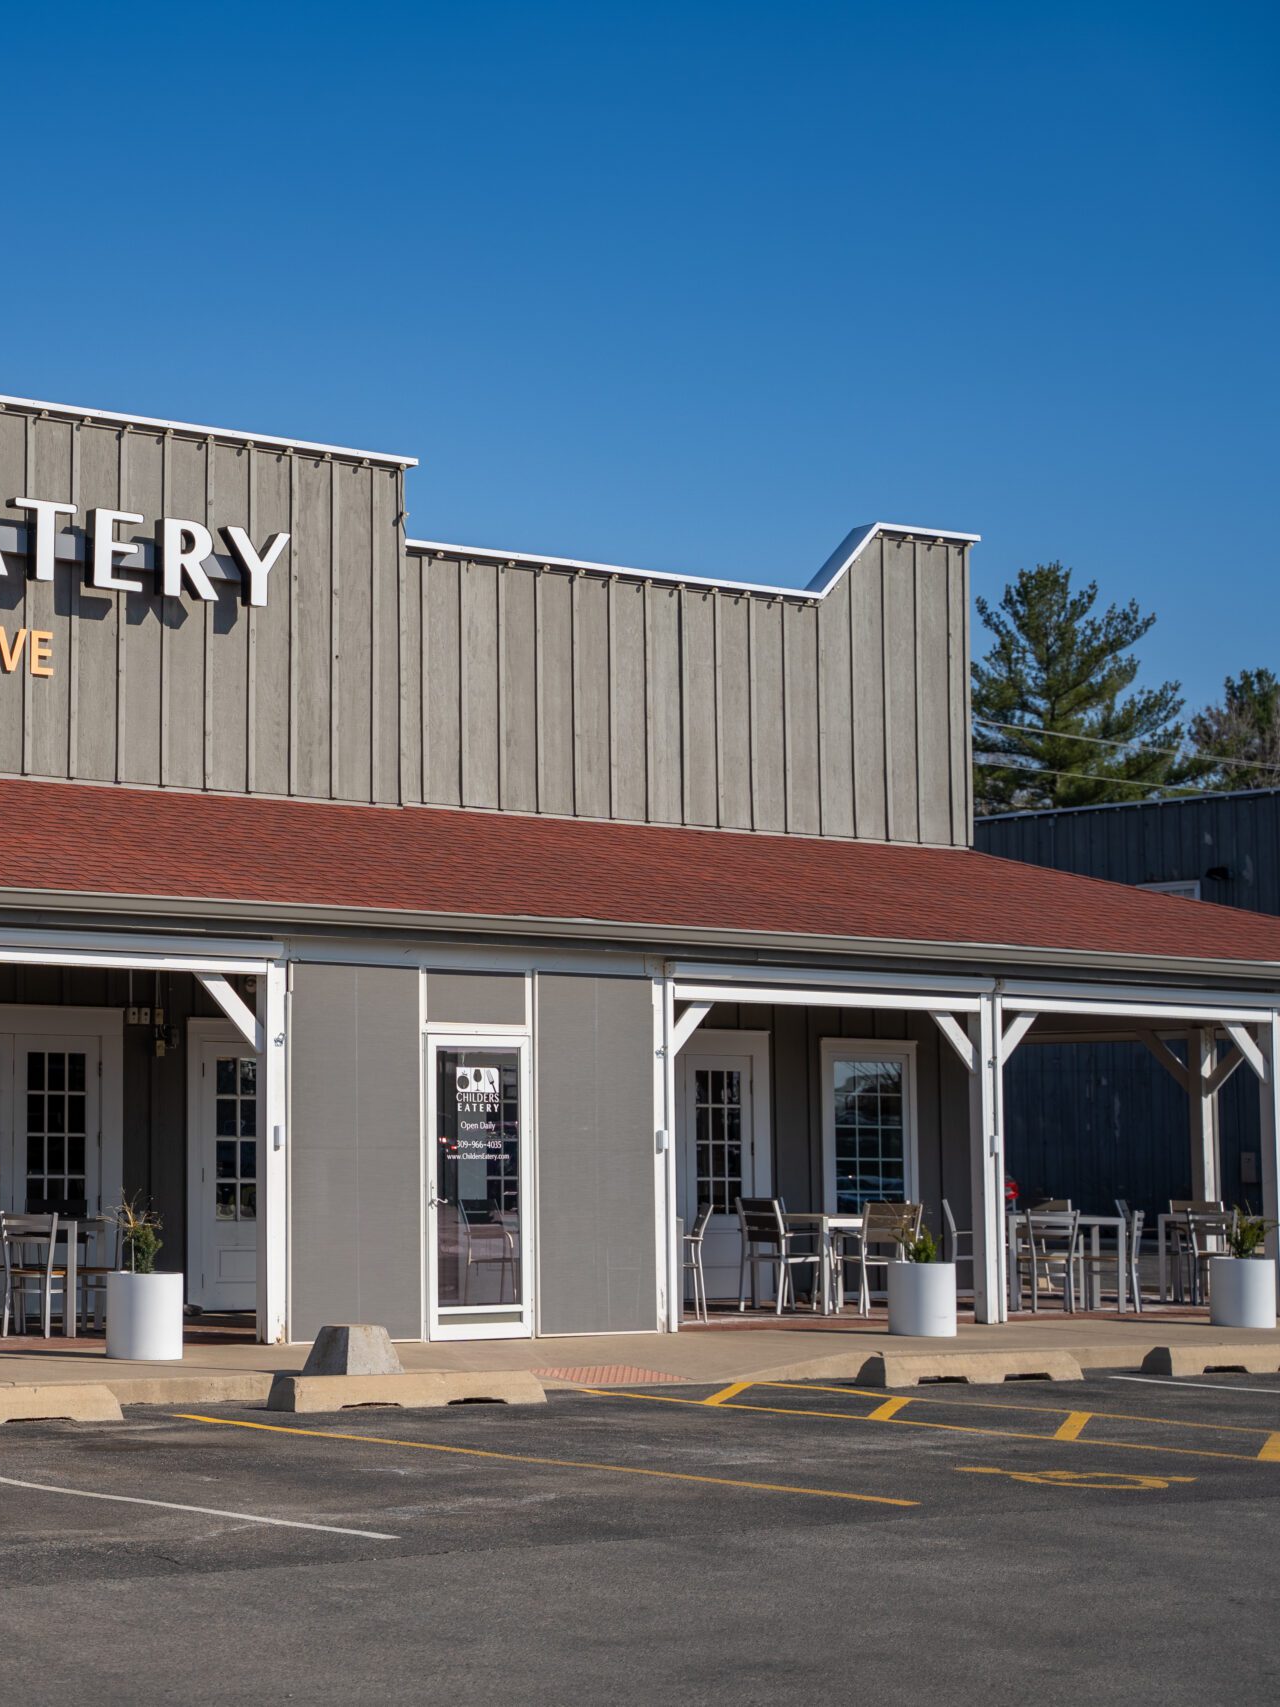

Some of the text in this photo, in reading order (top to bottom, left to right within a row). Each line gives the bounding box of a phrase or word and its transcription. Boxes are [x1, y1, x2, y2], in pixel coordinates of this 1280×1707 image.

[456, 1092, 499, 1103] CHILDERS
[457, 1103, 499, 1112] EATERY
[461, 1121, 496, 1131] Open Daily
[457, 1141, 501, 1149] 309-966-4035
